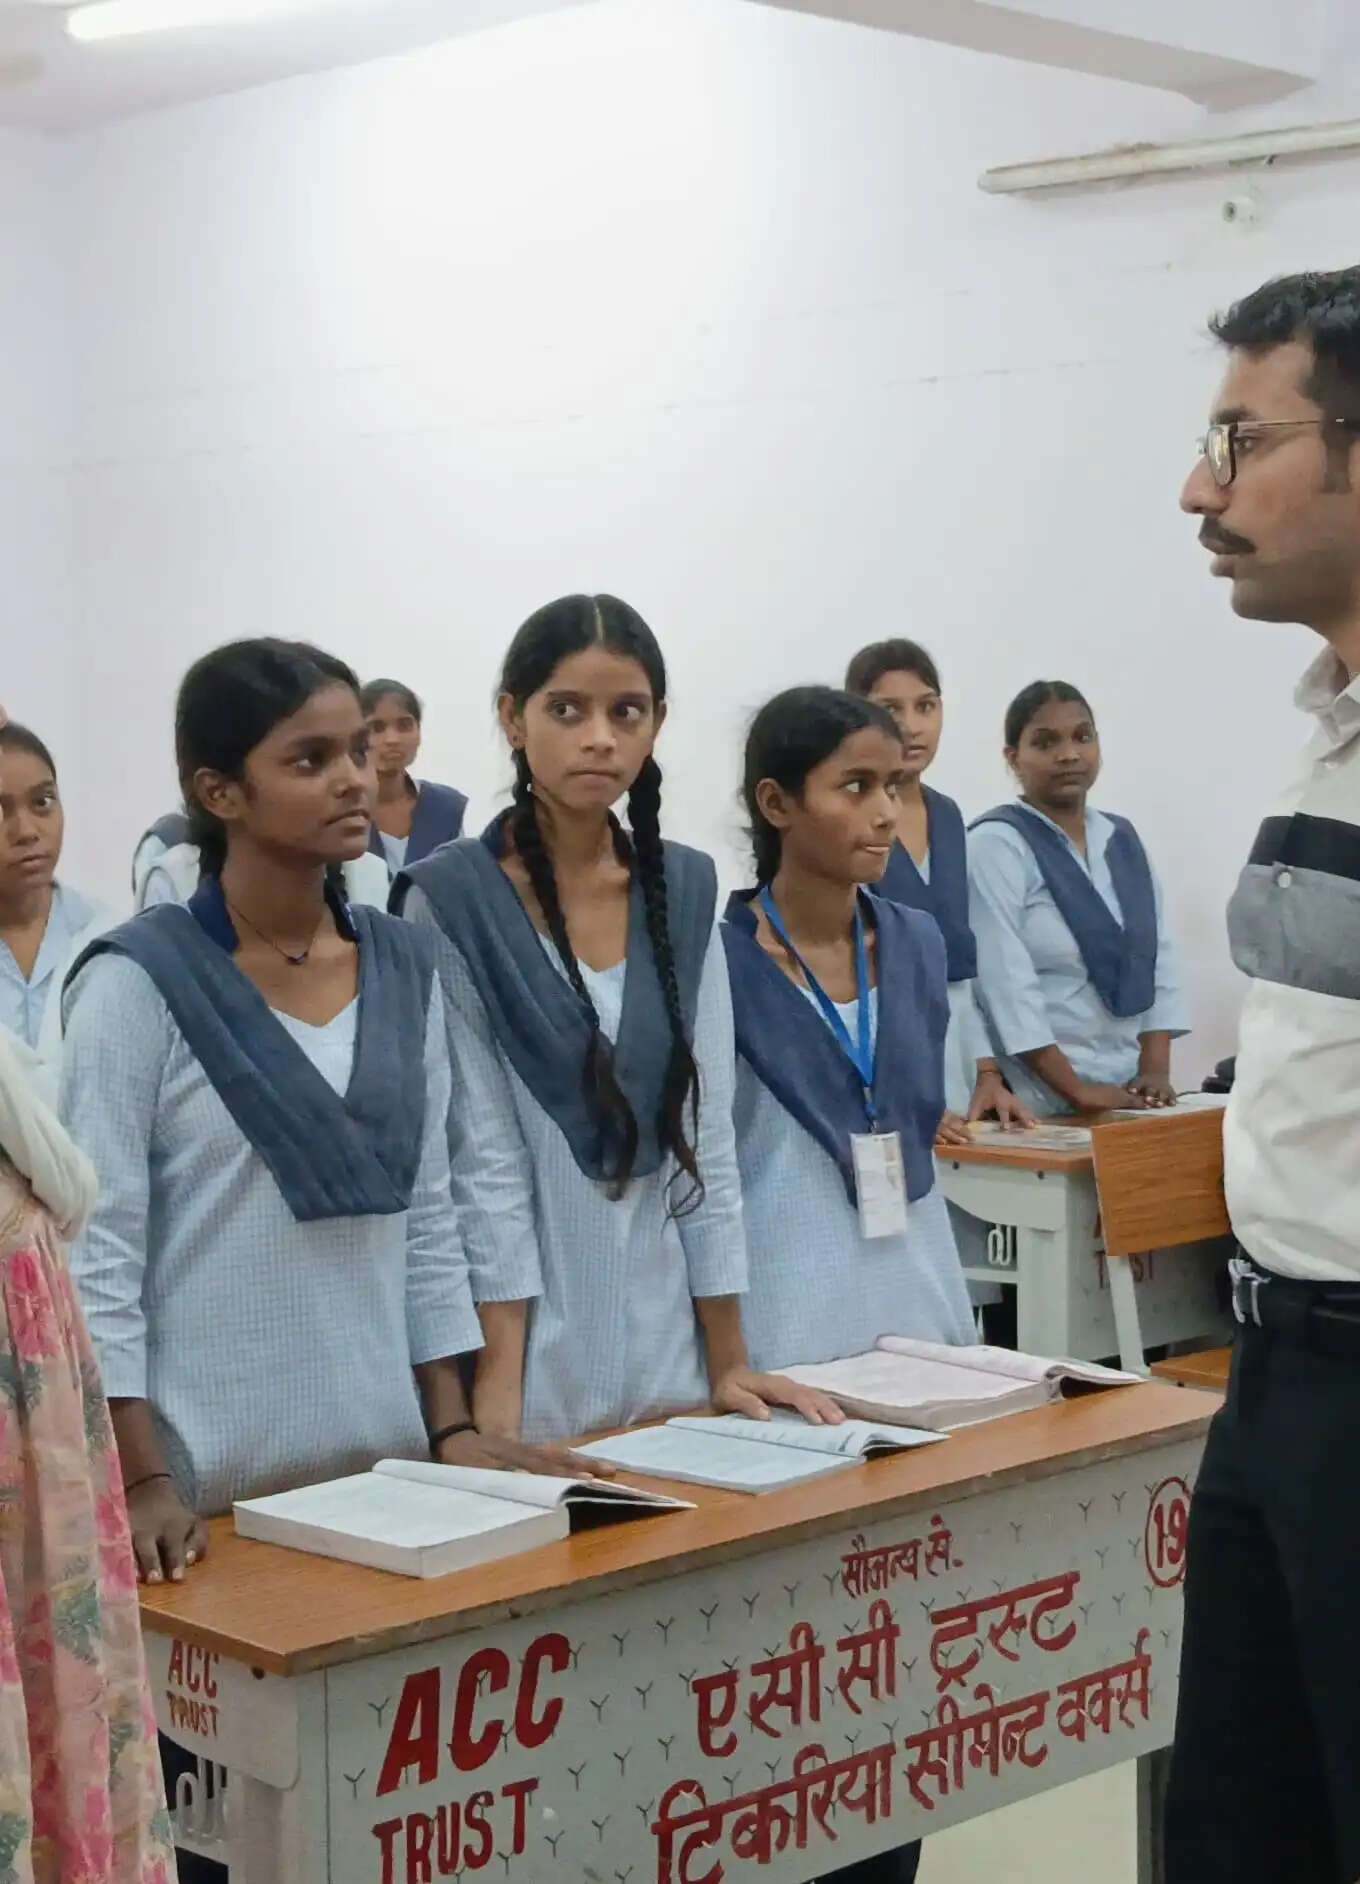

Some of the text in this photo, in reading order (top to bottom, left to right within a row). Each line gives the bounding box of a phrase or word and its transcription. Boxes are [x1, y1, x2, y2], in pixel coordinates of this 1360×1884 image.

[840, 1534, 920, 1598] सौजन्य
[1153, 1498, 1190, 1569] 19
[167, 1638, 219, 1699] ACC
[929, 1570, 1080, 1692] ट्रस्ट
[165, 1689, 220, 1737] TRUST
[376, 1633, 570, 1798] ACC
[650, 1743, 896, 1884] टिकरिया
[904, 1682, 1051, 1810] सीमेन्ट
[372, 1776, 540, 1884] TRUST
